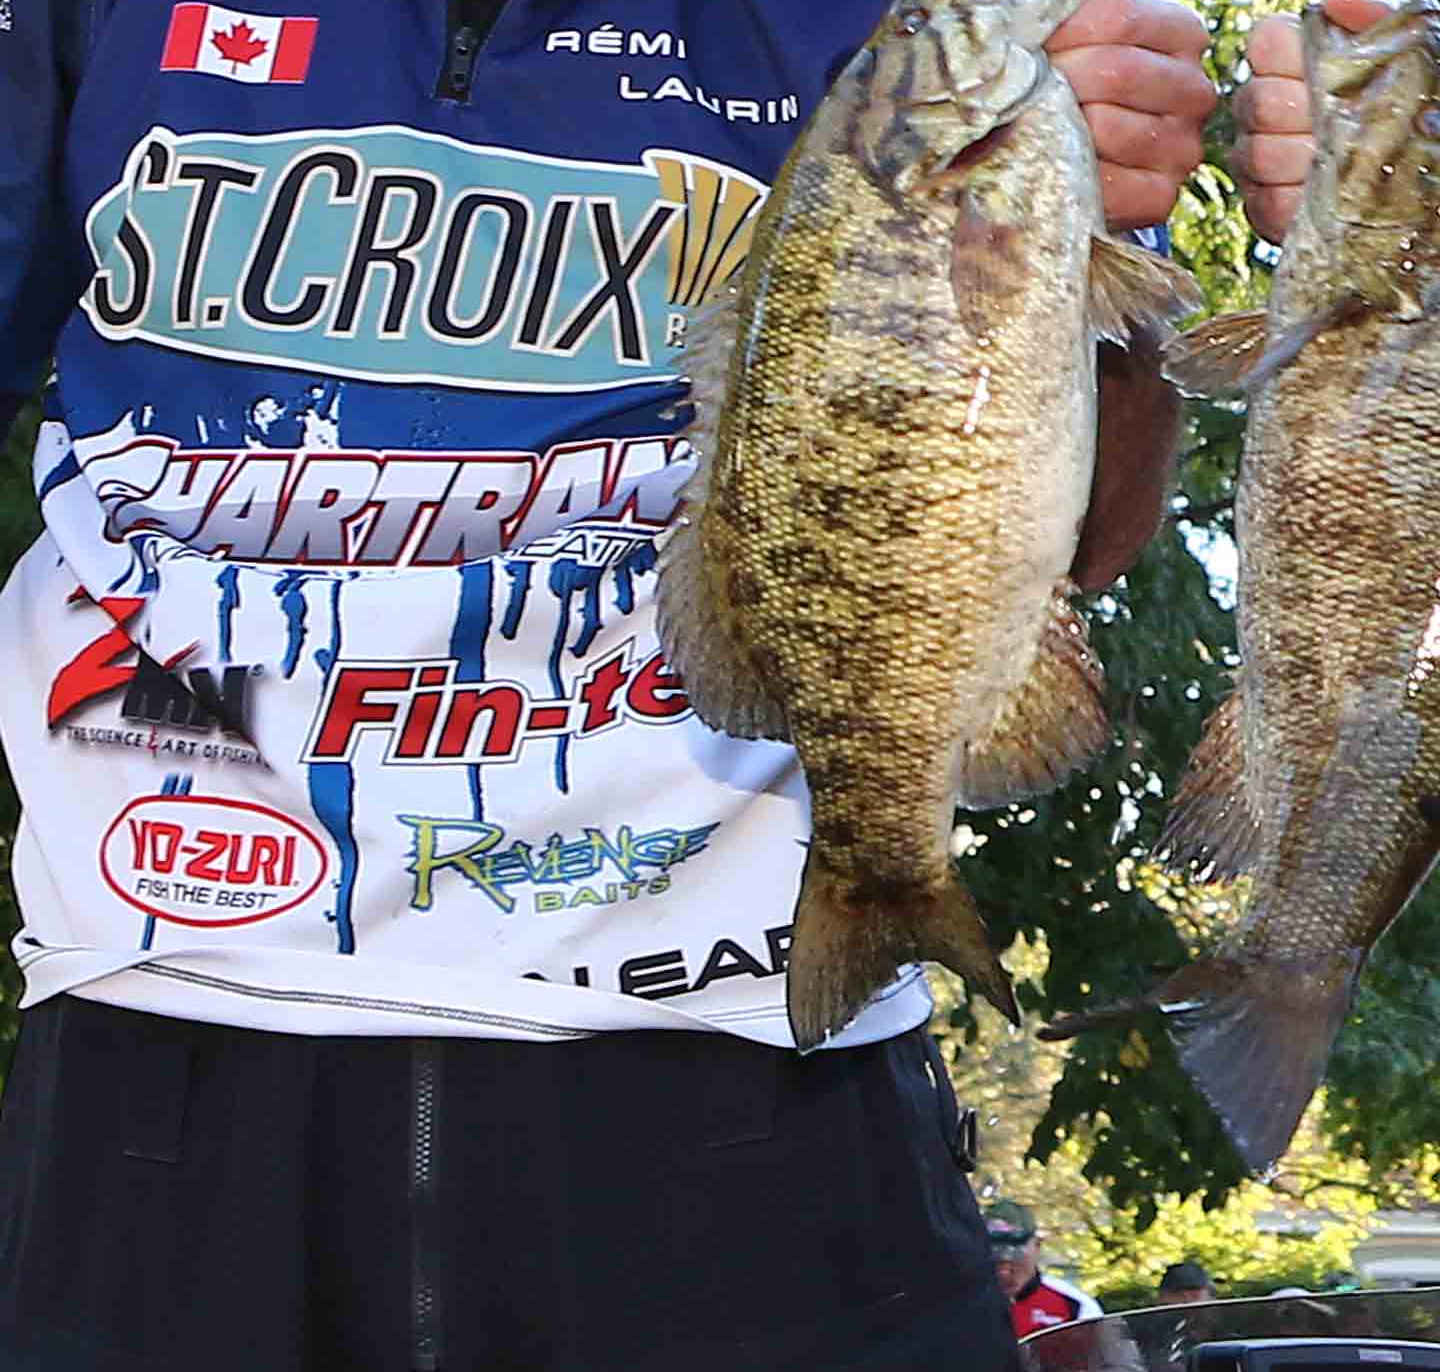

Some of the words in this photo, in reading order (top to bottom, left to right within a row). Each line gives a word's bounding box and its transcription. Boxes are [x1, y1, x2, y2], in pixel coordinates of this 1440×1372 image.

[545, 23, 687, 59] RÉMI
[618, 76, 799, 123] LAURIN
[89, 728, 144, 749] SCIENCE
[161, 738, 198, 759] ART
[128, 817, 298, 887] YO-ZURI
[396, 813, 722, 914] REVENGE
[136, 878, 170, 898] FISH
[171, 880, 211, 906] THE
[215, 885, 270, 909] BEST
[534, 874, 672, 914] BAITS
